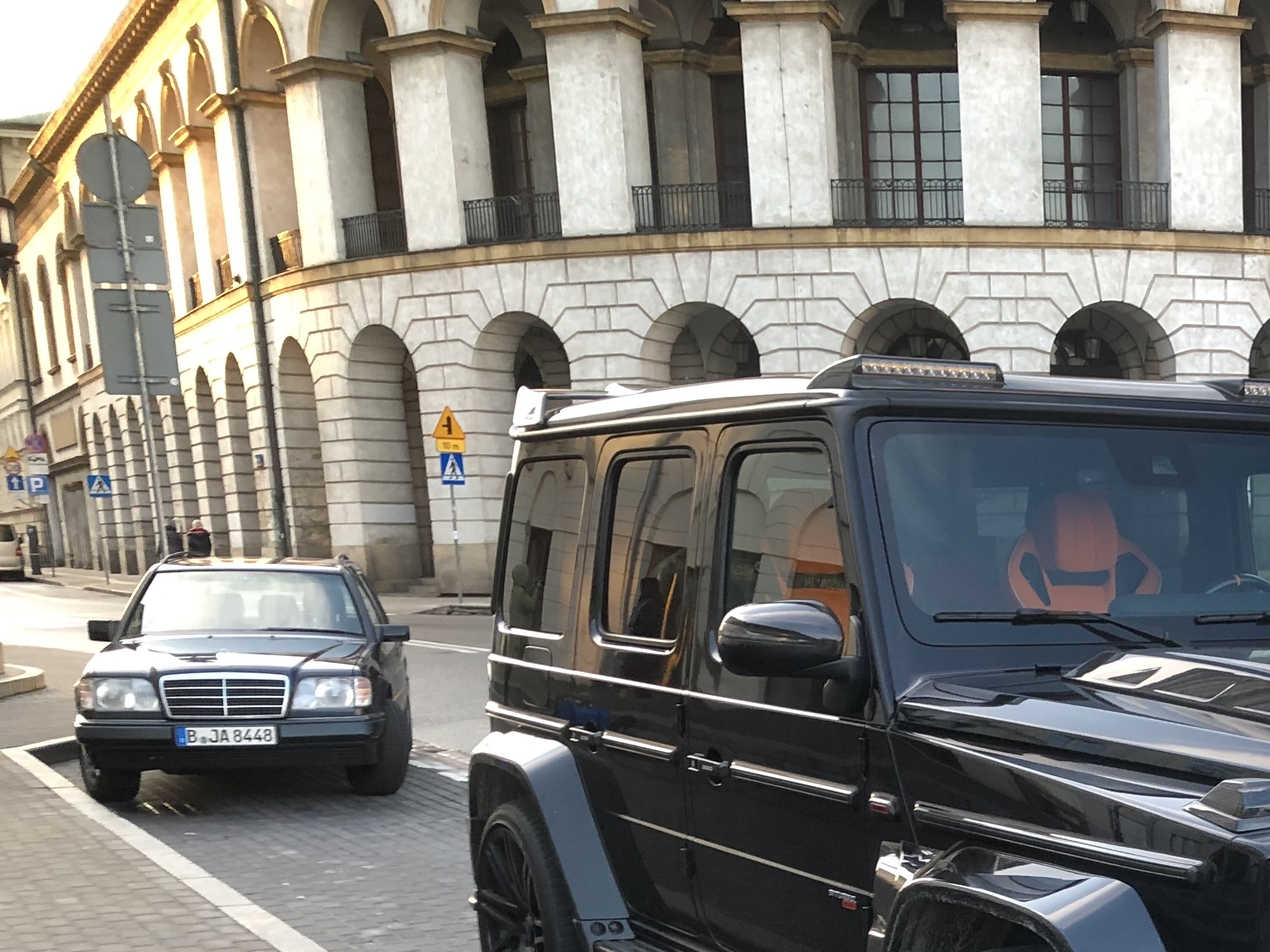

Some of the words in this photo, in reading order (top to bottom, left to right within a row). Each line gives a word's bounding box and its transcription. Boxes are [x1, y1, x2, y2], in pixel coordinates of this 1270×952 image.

[442, 441, 451, 450] 10
[30, 477, 44, 493] P
[187, 729, 198, 743] B
[209, 729, 230, 743] JA
[233, 728, 273, 743] 8448
